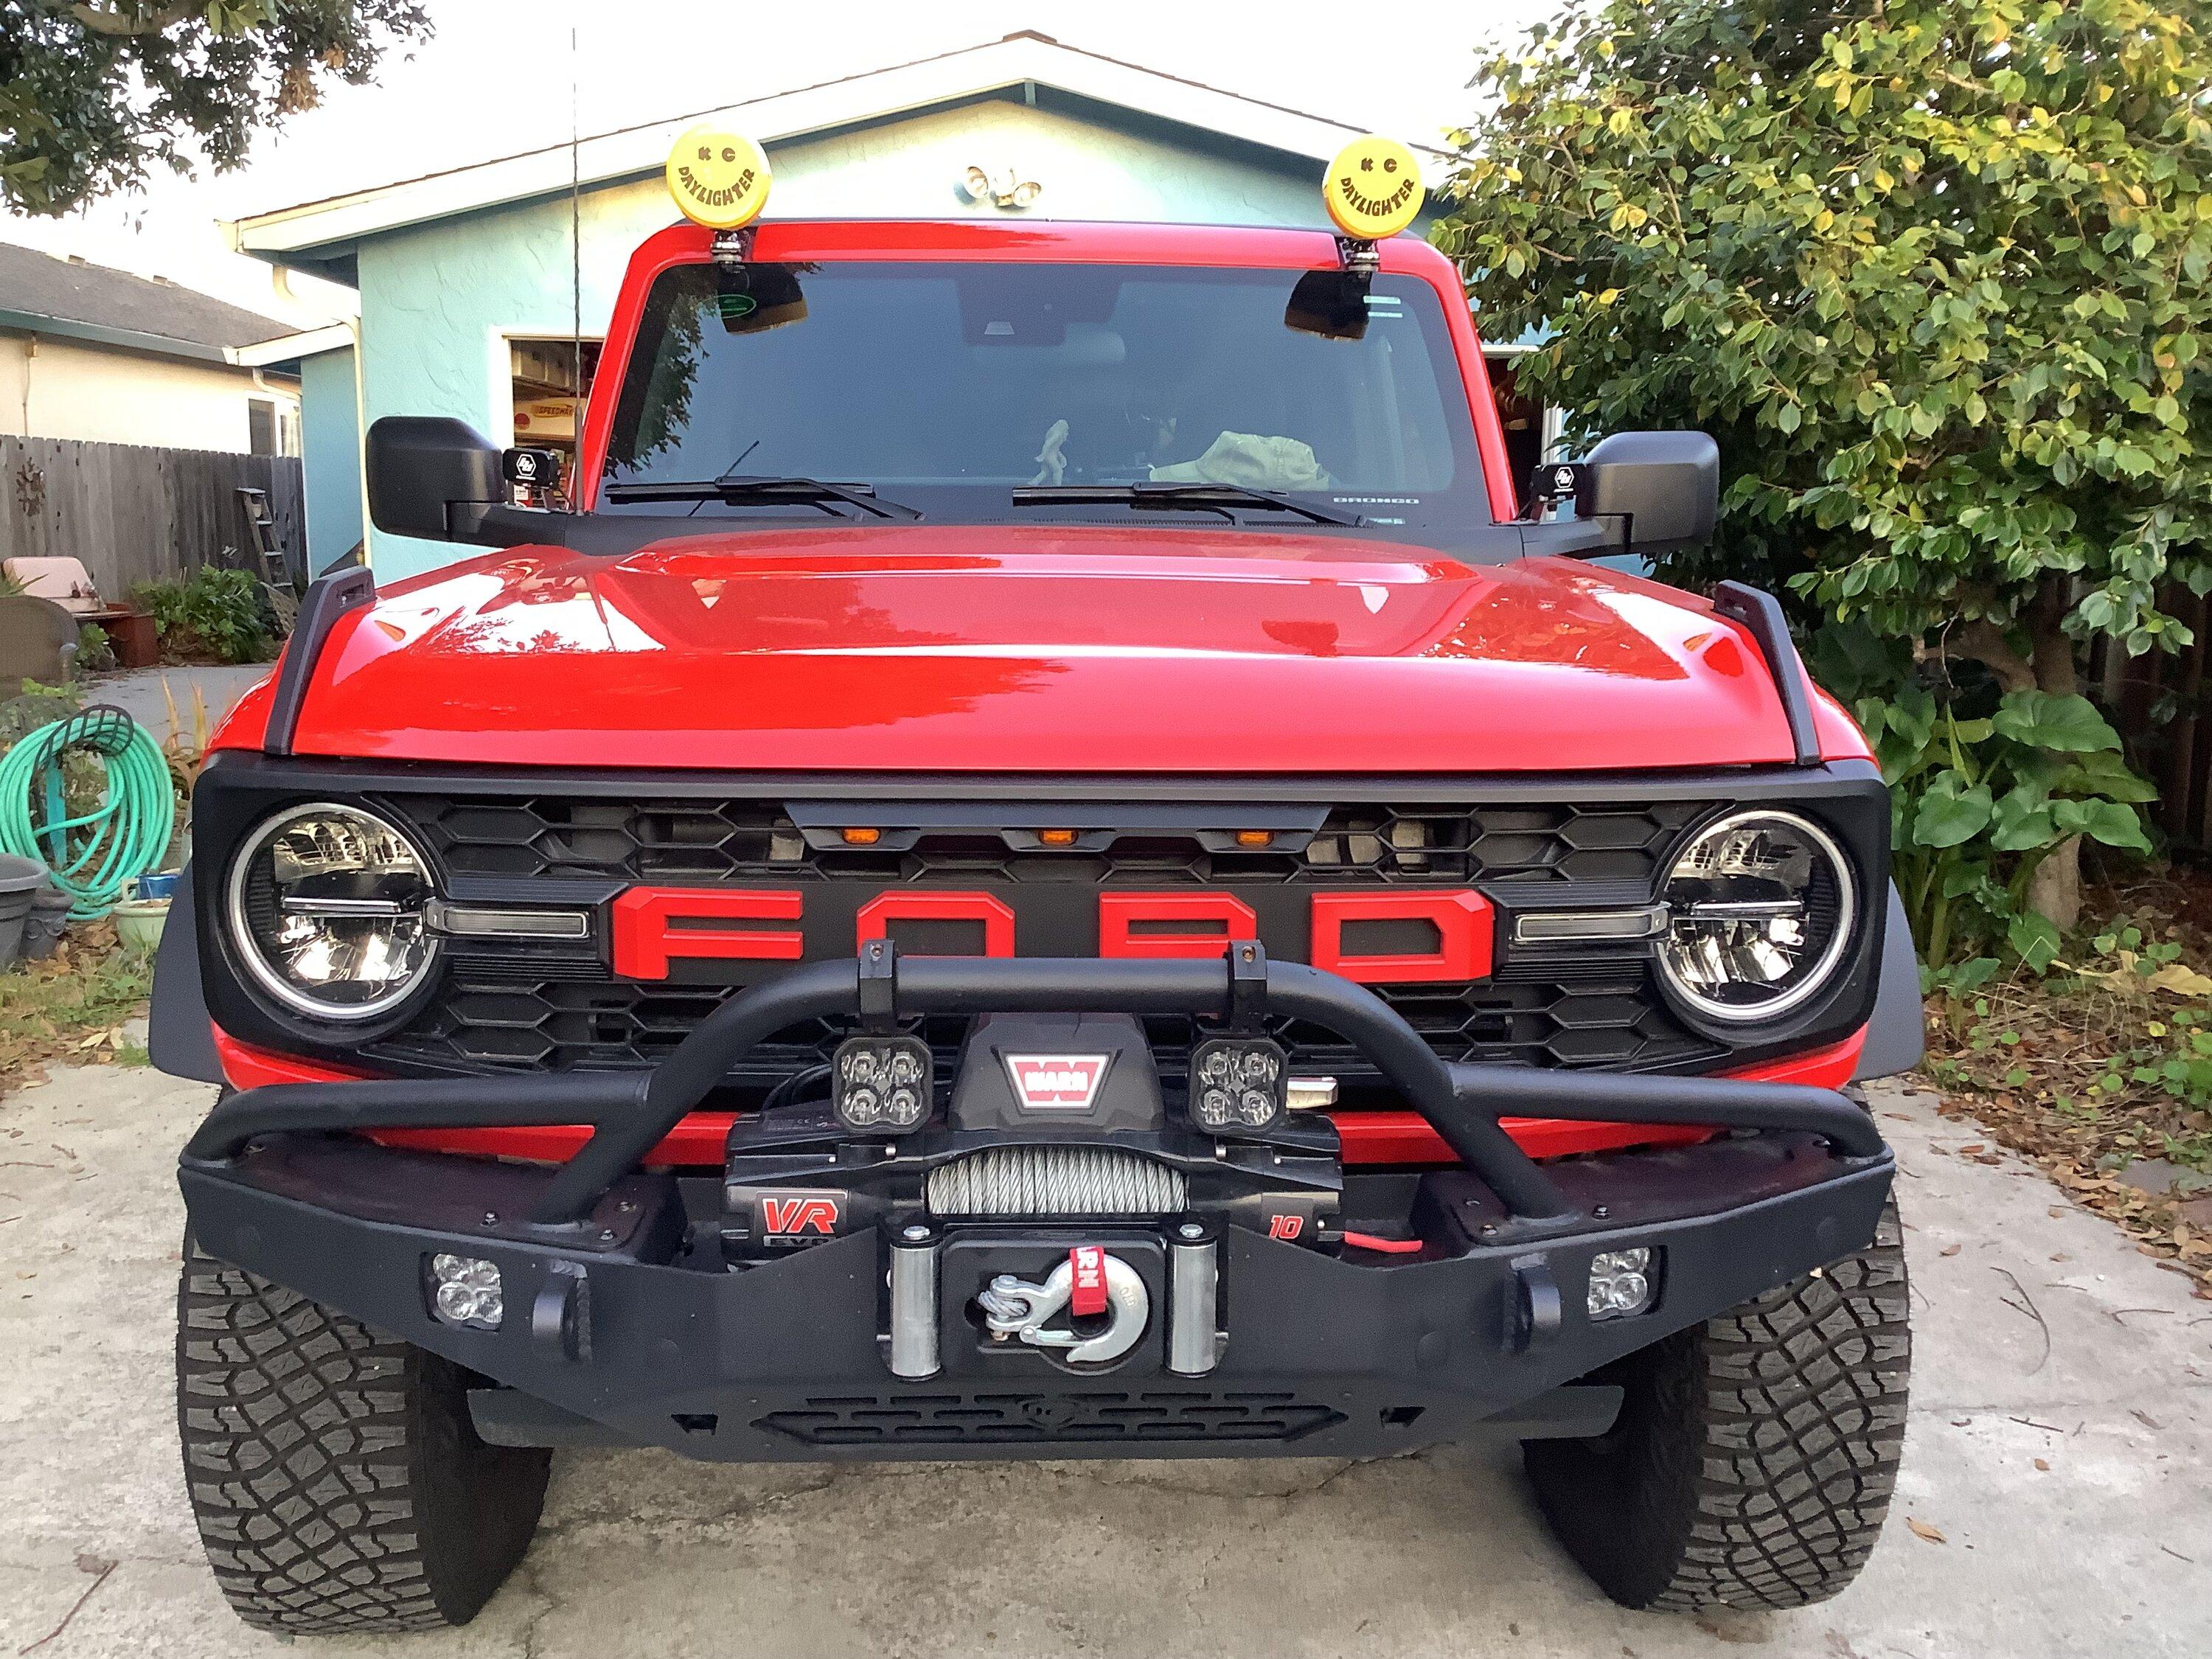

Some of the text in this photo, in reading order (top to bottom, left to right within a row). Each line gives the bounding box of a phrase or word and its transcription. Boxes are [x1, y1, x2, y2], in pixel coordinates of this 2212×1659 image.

[678, 167, 754, 206] DAYLIGHTER
[1340, 177, 1414, 216] DAYLIGHTER
[613, 889, 1492, 981] FORD
[762, 1198, 838, 1234] VR
[1269, 1215, 1304, 1239] 10
